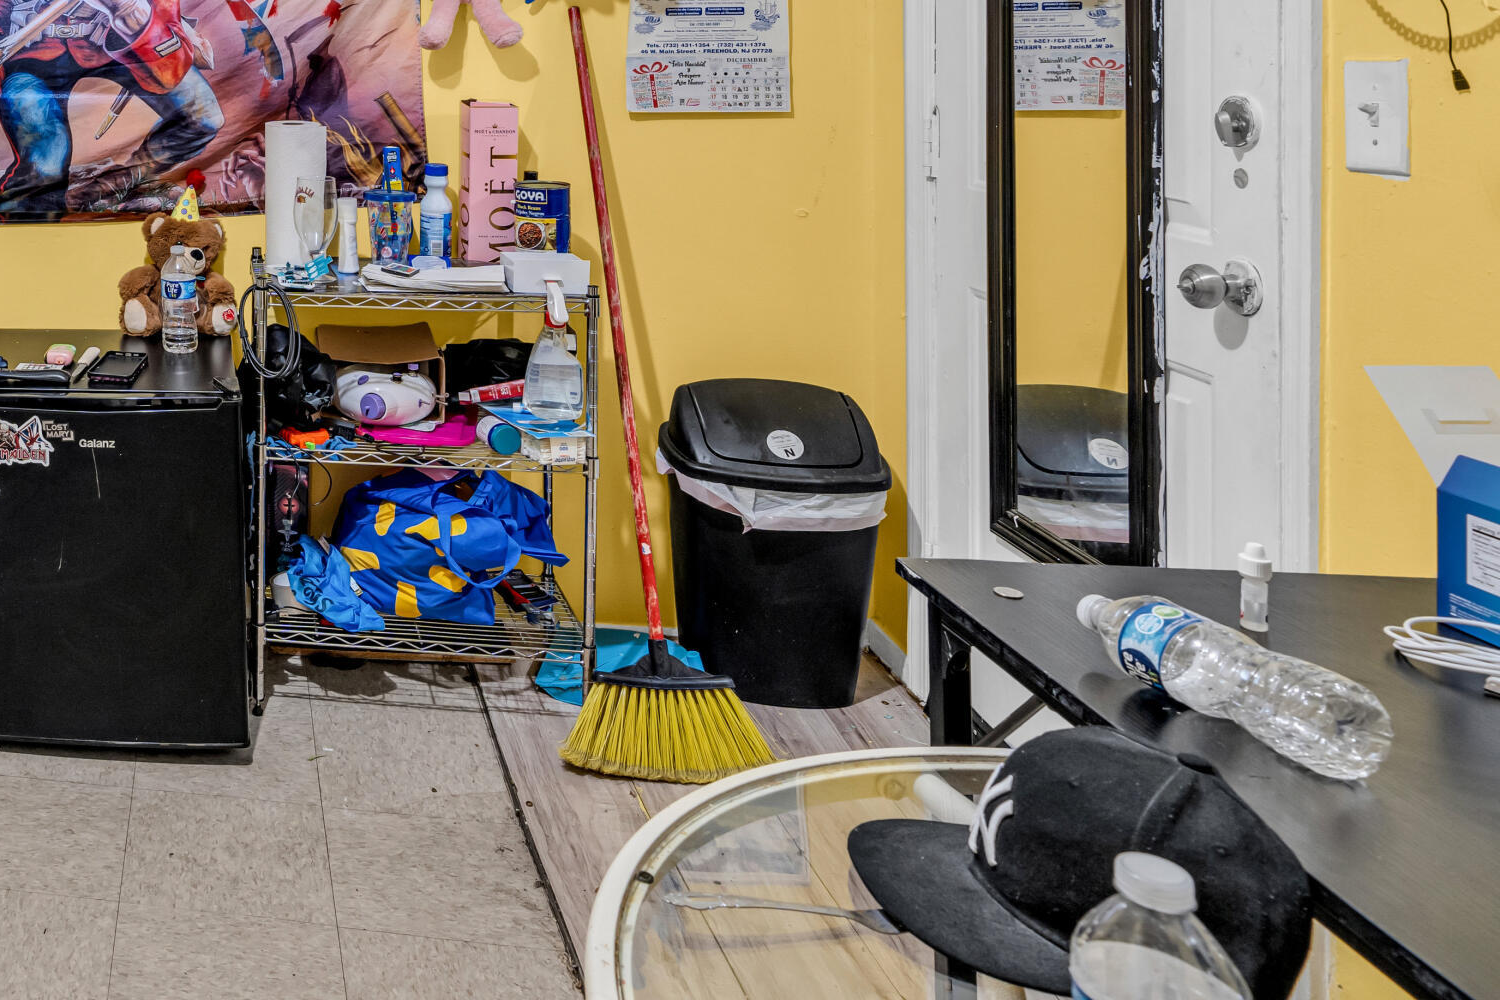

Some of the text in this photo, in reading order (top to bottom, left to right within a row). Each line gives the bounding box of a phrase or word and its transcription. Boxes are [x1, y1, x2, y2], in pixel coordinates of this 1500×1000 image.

[515, 189, 545, 201] GOYA
[46, 423, 69, 431] LOST
[46, 430, 70, 438] MARY
[78, 438, 116, 449] Galanz
[0, 447, 47, 463] MAIDEN
